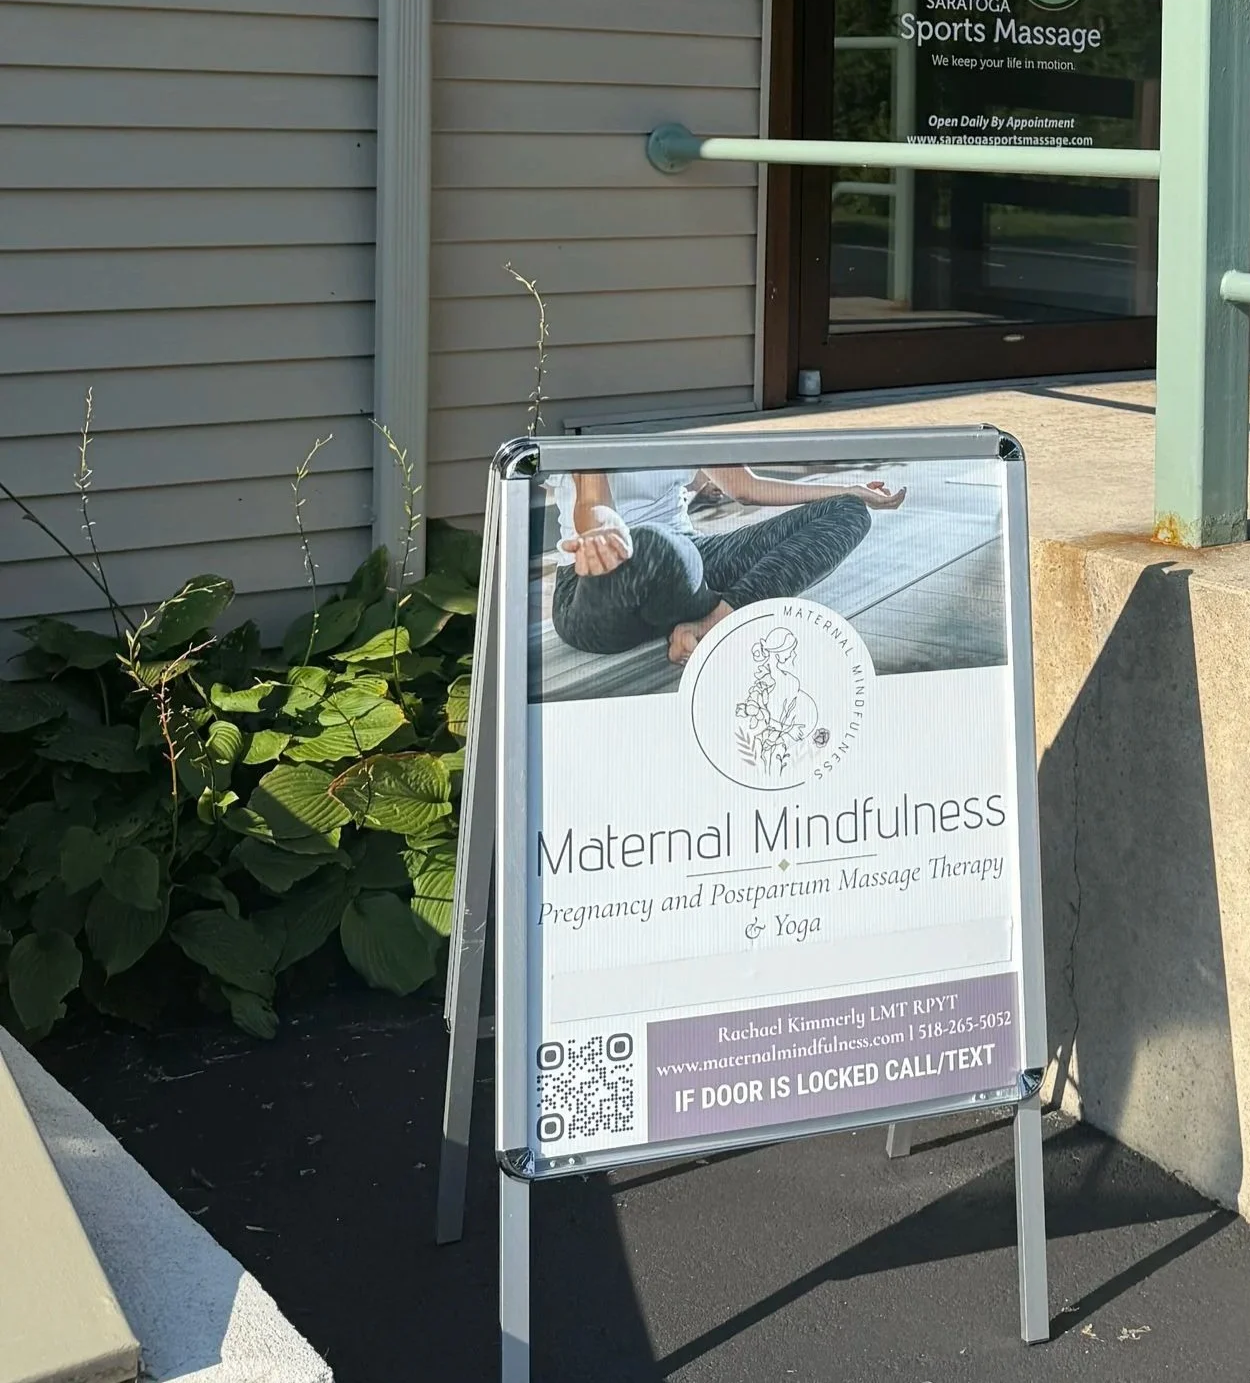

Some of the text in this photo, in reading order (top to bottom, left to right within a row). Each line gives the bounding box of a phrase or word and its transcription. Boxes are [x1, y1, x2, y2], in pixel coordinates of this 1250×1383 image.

[900, 12, 1101, 53] Sports Massage
[932, 54, 1076, 71] We keep your life in motion.
[906, 133, 1093, 147] www.saratogasportsmassage.com
[928, 115, 1075, 130] Open Daily By Appointment
[783, 605, 865, 780] MATERNAL MINDFULNESS
[537, 793, 1006, 877] Maternal Mindfulness
[537, 854, 1004, 930] Pregnancy and Postpartum Massage Therapy
[745, 913, 822, 942] & Yoga
[718, 994, 959, 1043] Rachael Kimmerly LMT RPYT
[656, 1032, 904, 1077] www.maternalmindfulness.com
[918, 1010, 1012, 1039] 518-265-5052
[675, 1043, 996, 1113] IF DOOR IS LOCKED CALL/TEXT
